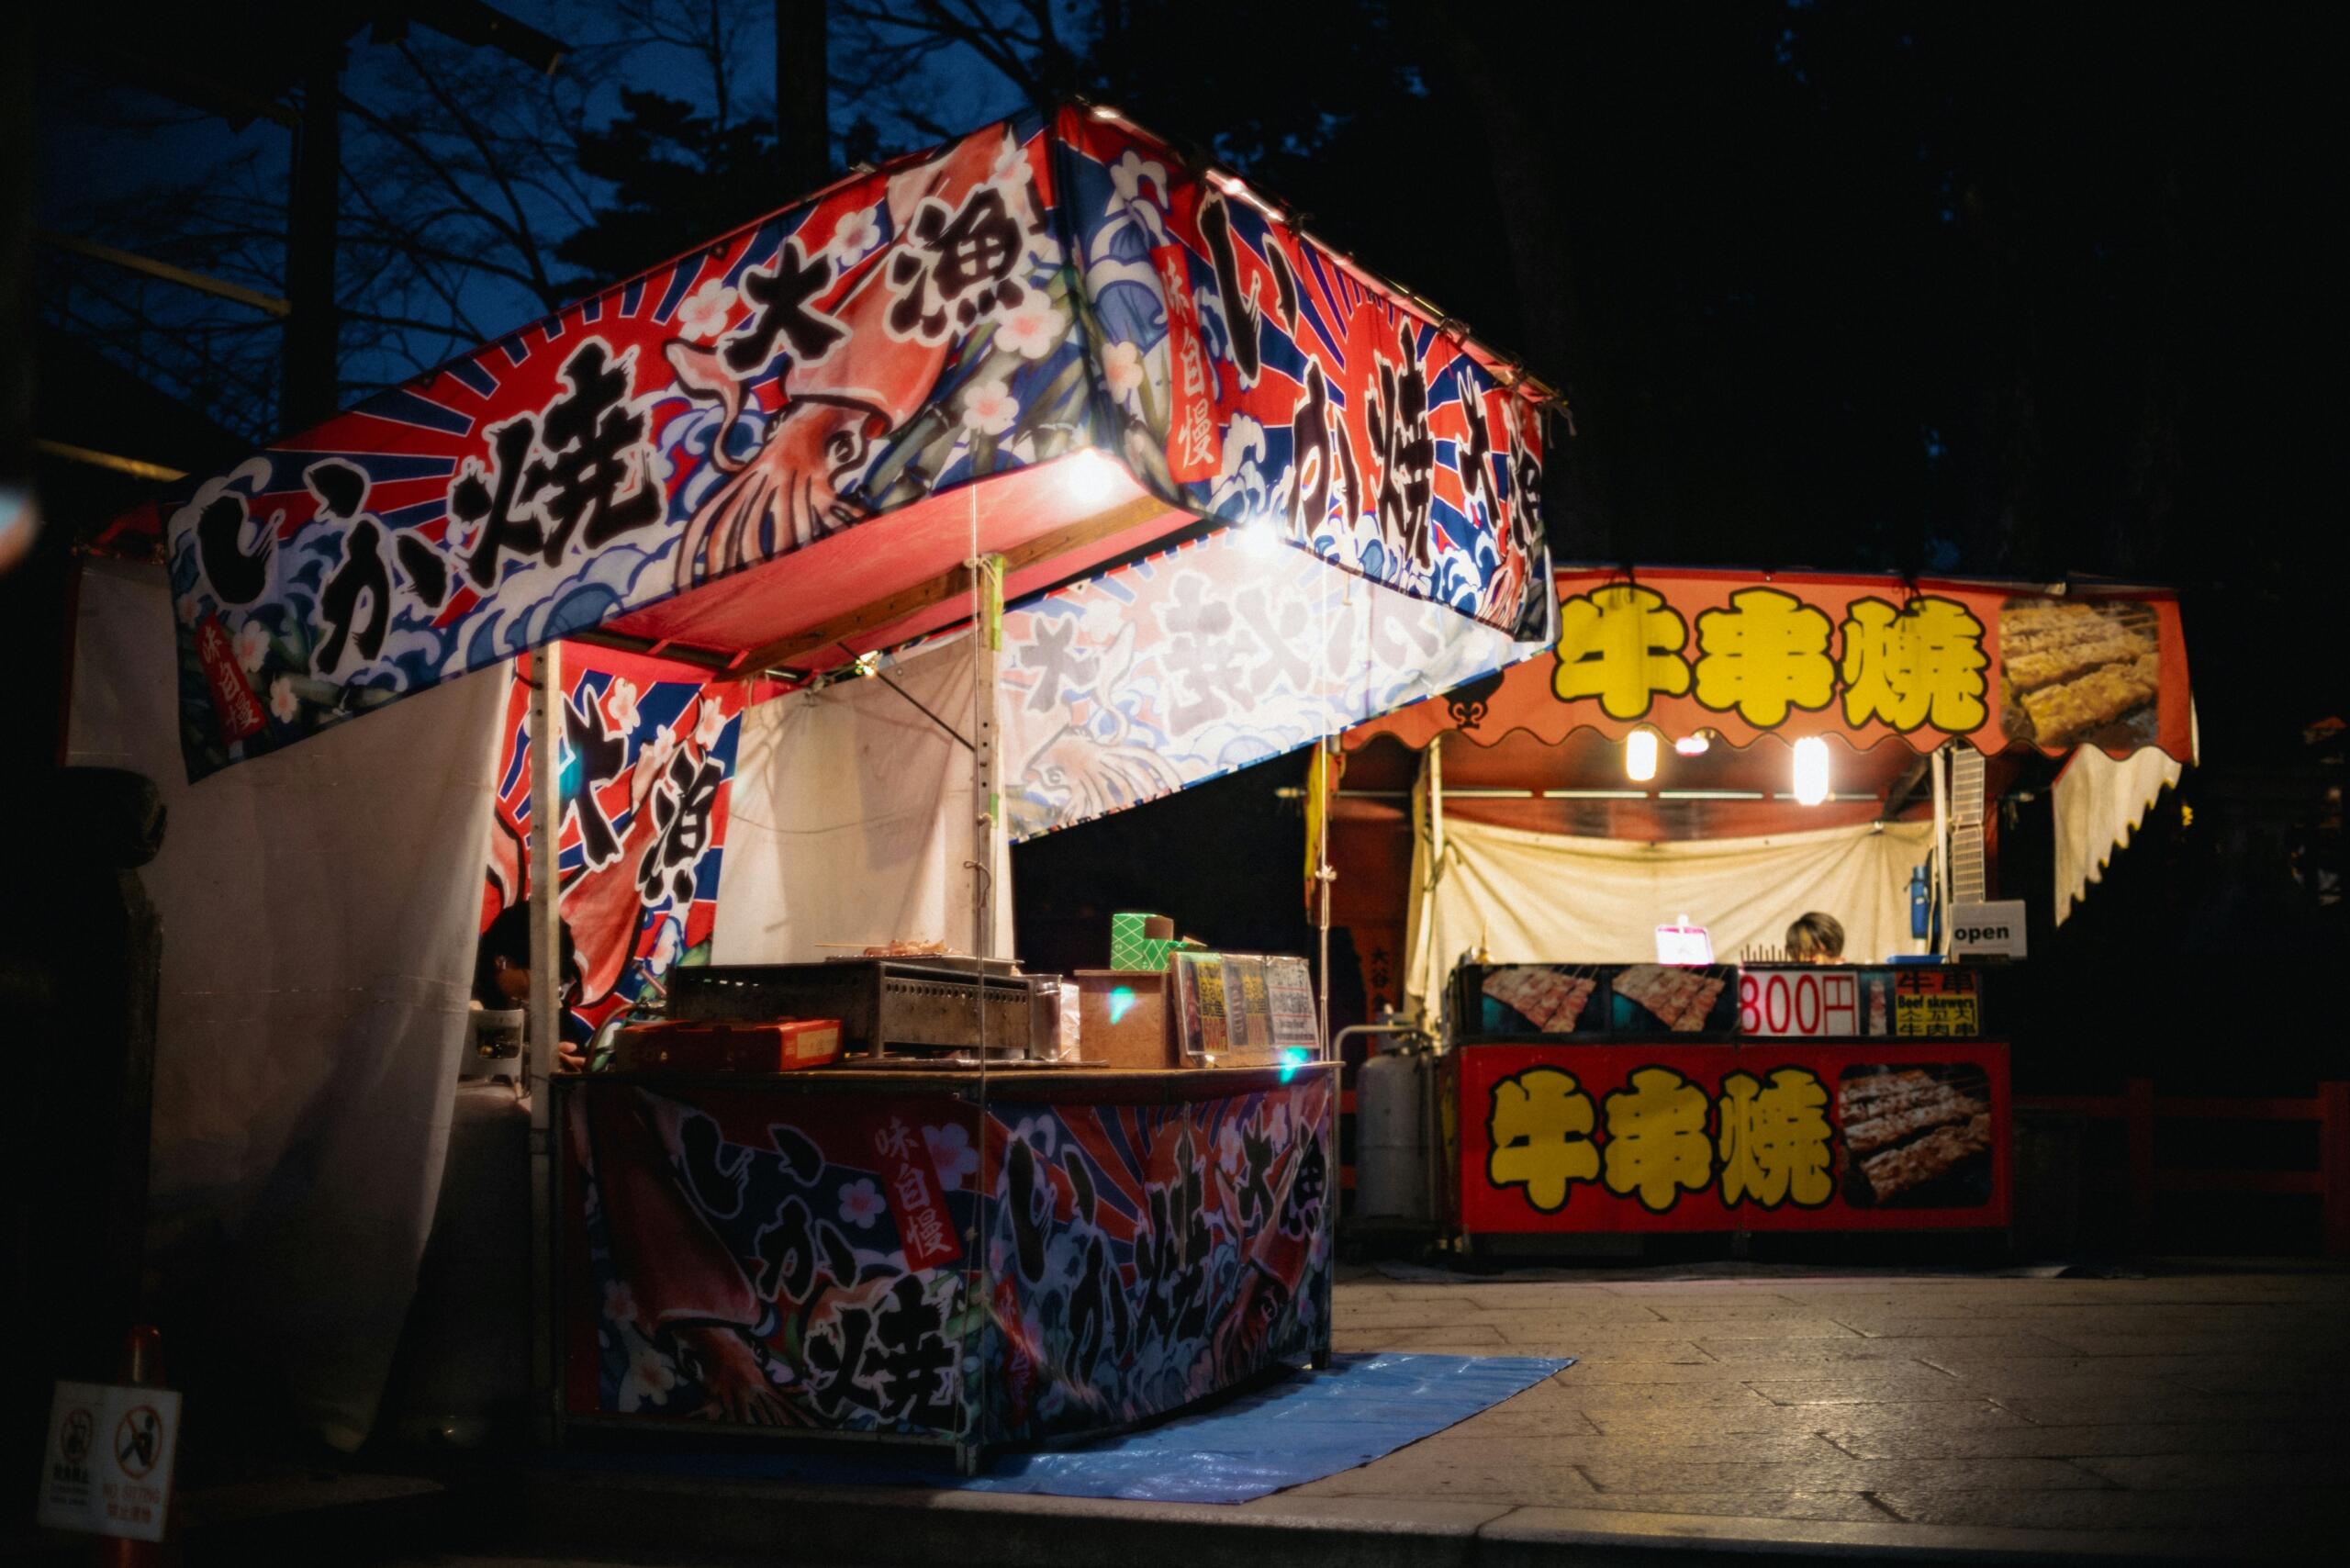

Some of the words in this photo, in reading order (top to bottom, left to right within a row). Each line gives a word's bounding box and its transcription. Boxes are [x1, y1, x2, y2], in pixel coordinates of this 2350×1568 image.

[196, 341, 662, 676] いか焼
[725, 188, 1026, 369] 大漁
[1163, 256, 1216, 468] 味自慢
[1198, 193, 1434, 566] いか焼
[202, 624, 261, 735] 味自慢
[1551, 584, 1990, 733] 牛串焼
[1739, 973, 1857, 1036] 800円
[1898, 995, 1924, 1008] Beef
[1927, 995, 1974, 1008] skewers
[1954, 926, 2009, 944] open
[874, 1116, 953, 1258] 味自慢
[1487, 1066, 1835, 1213] 牛串焼
[681, 1115, 966, 1432] いか焼
[1009, 1133, 1211, 1382] いか焼
